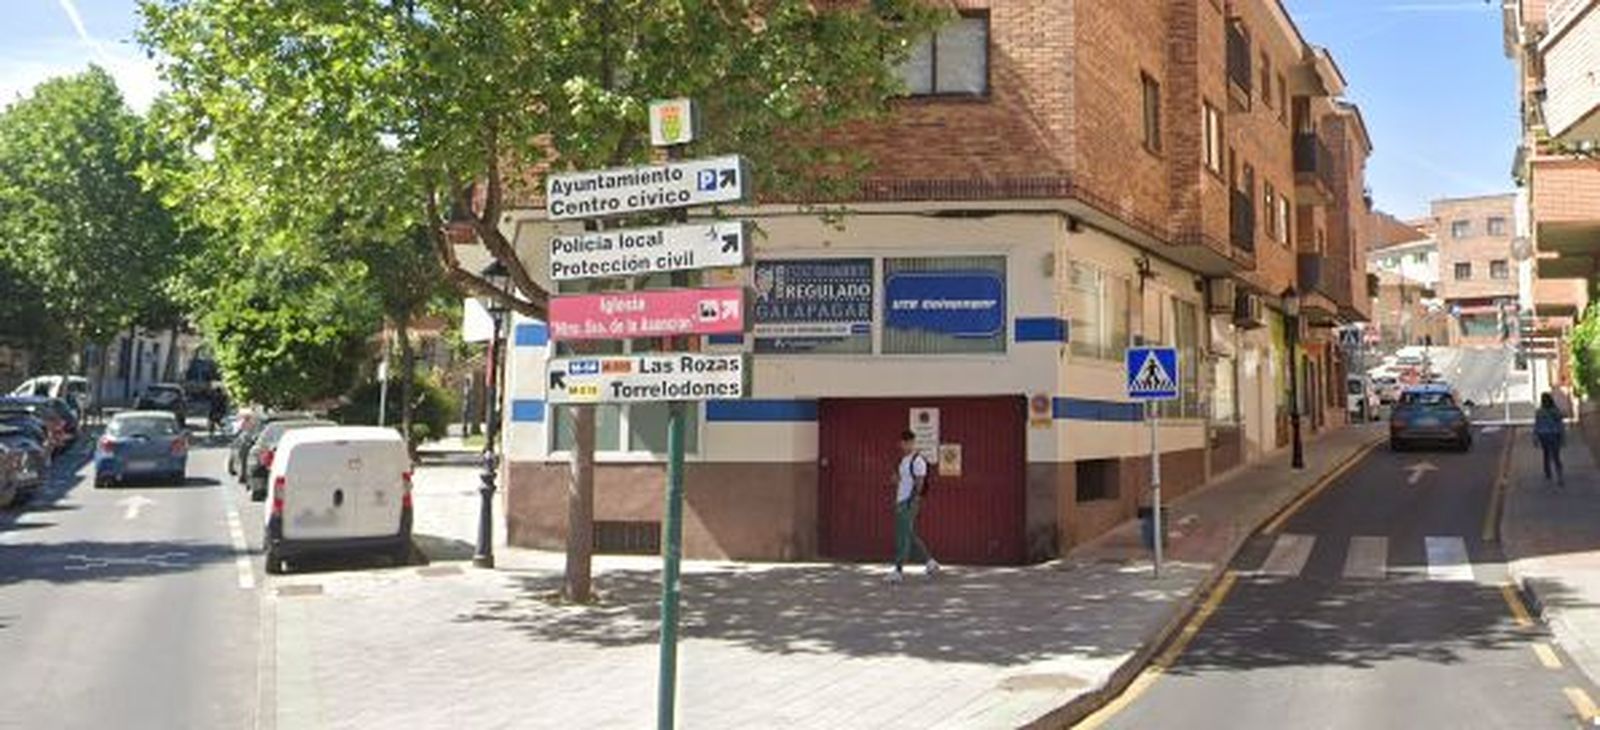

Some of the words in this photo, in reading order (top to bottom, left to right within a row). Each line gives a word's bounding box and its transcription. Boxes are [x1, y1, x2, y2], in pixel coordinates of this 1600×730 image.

[551, 167, 683, 197] Ayuntamiento
[551, 197, 620, 216] Centro
[619, 231, 664, 248] local
[656, 251, 694, 268] civil
[786, 284, 871, 299] REGULADO
[756, 304, 870, 318] GALAPAGAR
[639, 357, 673, 374] Las
[681, 357, 739, 373] Rozas
[611, 380, 739, 398] Torrelodones
